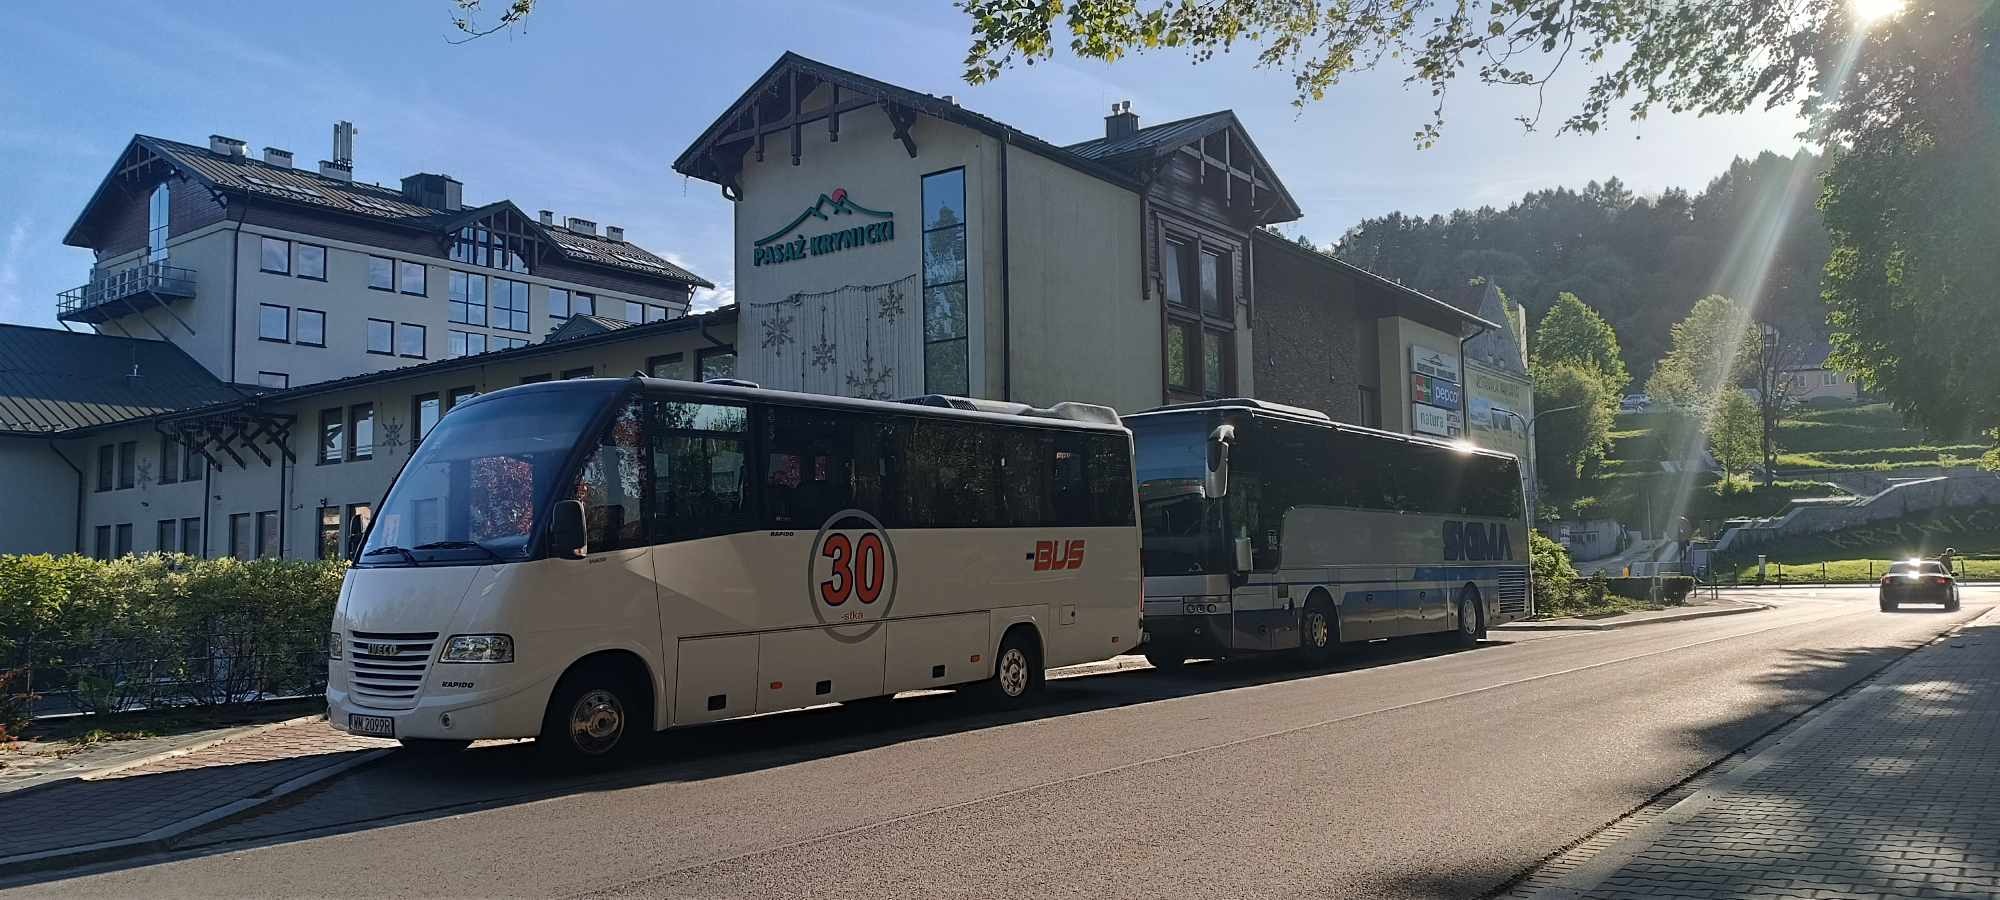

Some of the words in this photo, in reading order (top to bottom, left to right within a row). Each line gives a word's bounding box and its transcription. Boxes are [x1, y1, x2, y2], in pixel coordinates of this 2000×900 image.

[754, 234, 806, 266] PASAŻ
[810, 221, 894, 256] KRYNICKI
[1435, 386, 1458, 403] pepco
[1420, 411, 1444, 428] natura
[1443, 520, 1513, 560] SIGMA
[821, 532, 884, 606] 30
[368, 643, 397, 656] IVECO
[365, 717, 391, 732] 2099R
